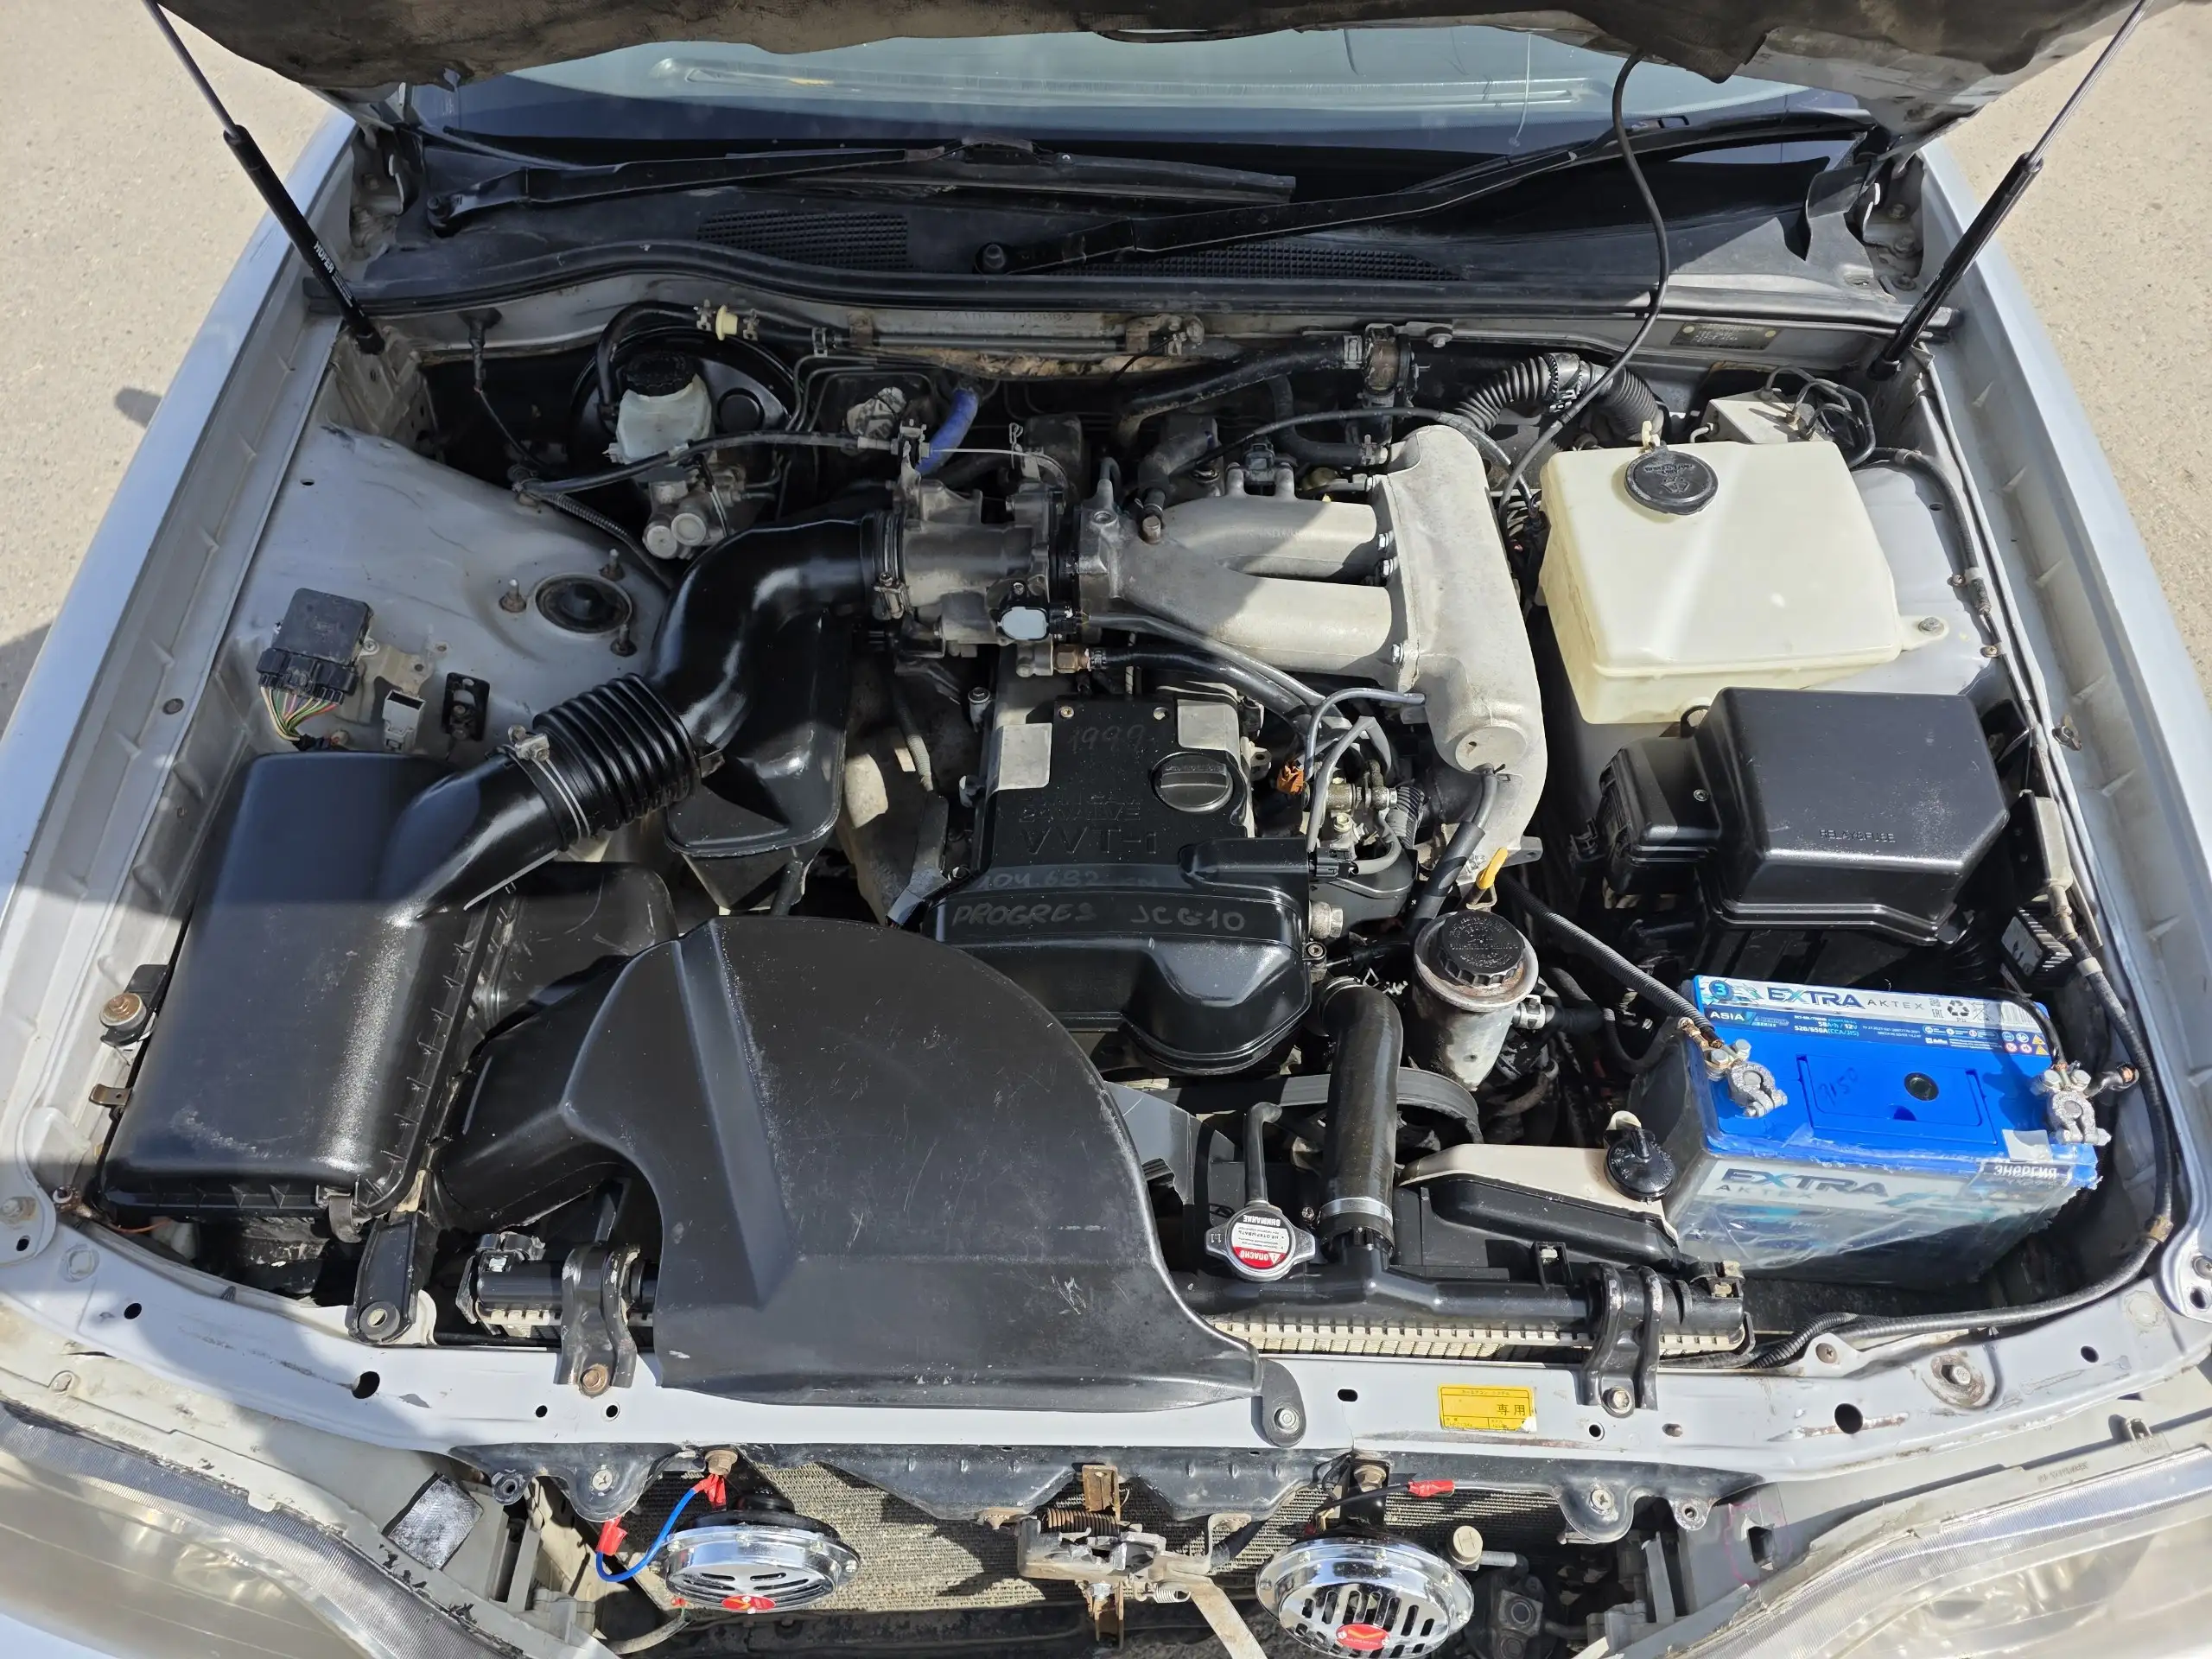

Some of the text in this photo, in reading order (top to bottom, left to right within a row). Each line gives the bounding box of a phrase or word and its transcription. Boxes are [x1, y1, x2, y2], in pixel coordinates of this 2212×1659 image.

[1767, 987, 1925, 1011] EXTRA AKTEX
[1710, 1011, 1745, 1022] ASIA
[1721, 1167, 1890, 1198] EXTRA
[1716, 1184, 1813, 1199] AKTEX
[1210, 1233, 1222, 1243] 1.1
[1239, 1249, 1269, 1262] ОПАСНО
[1497, 1403, 1527, 1416] 専用
